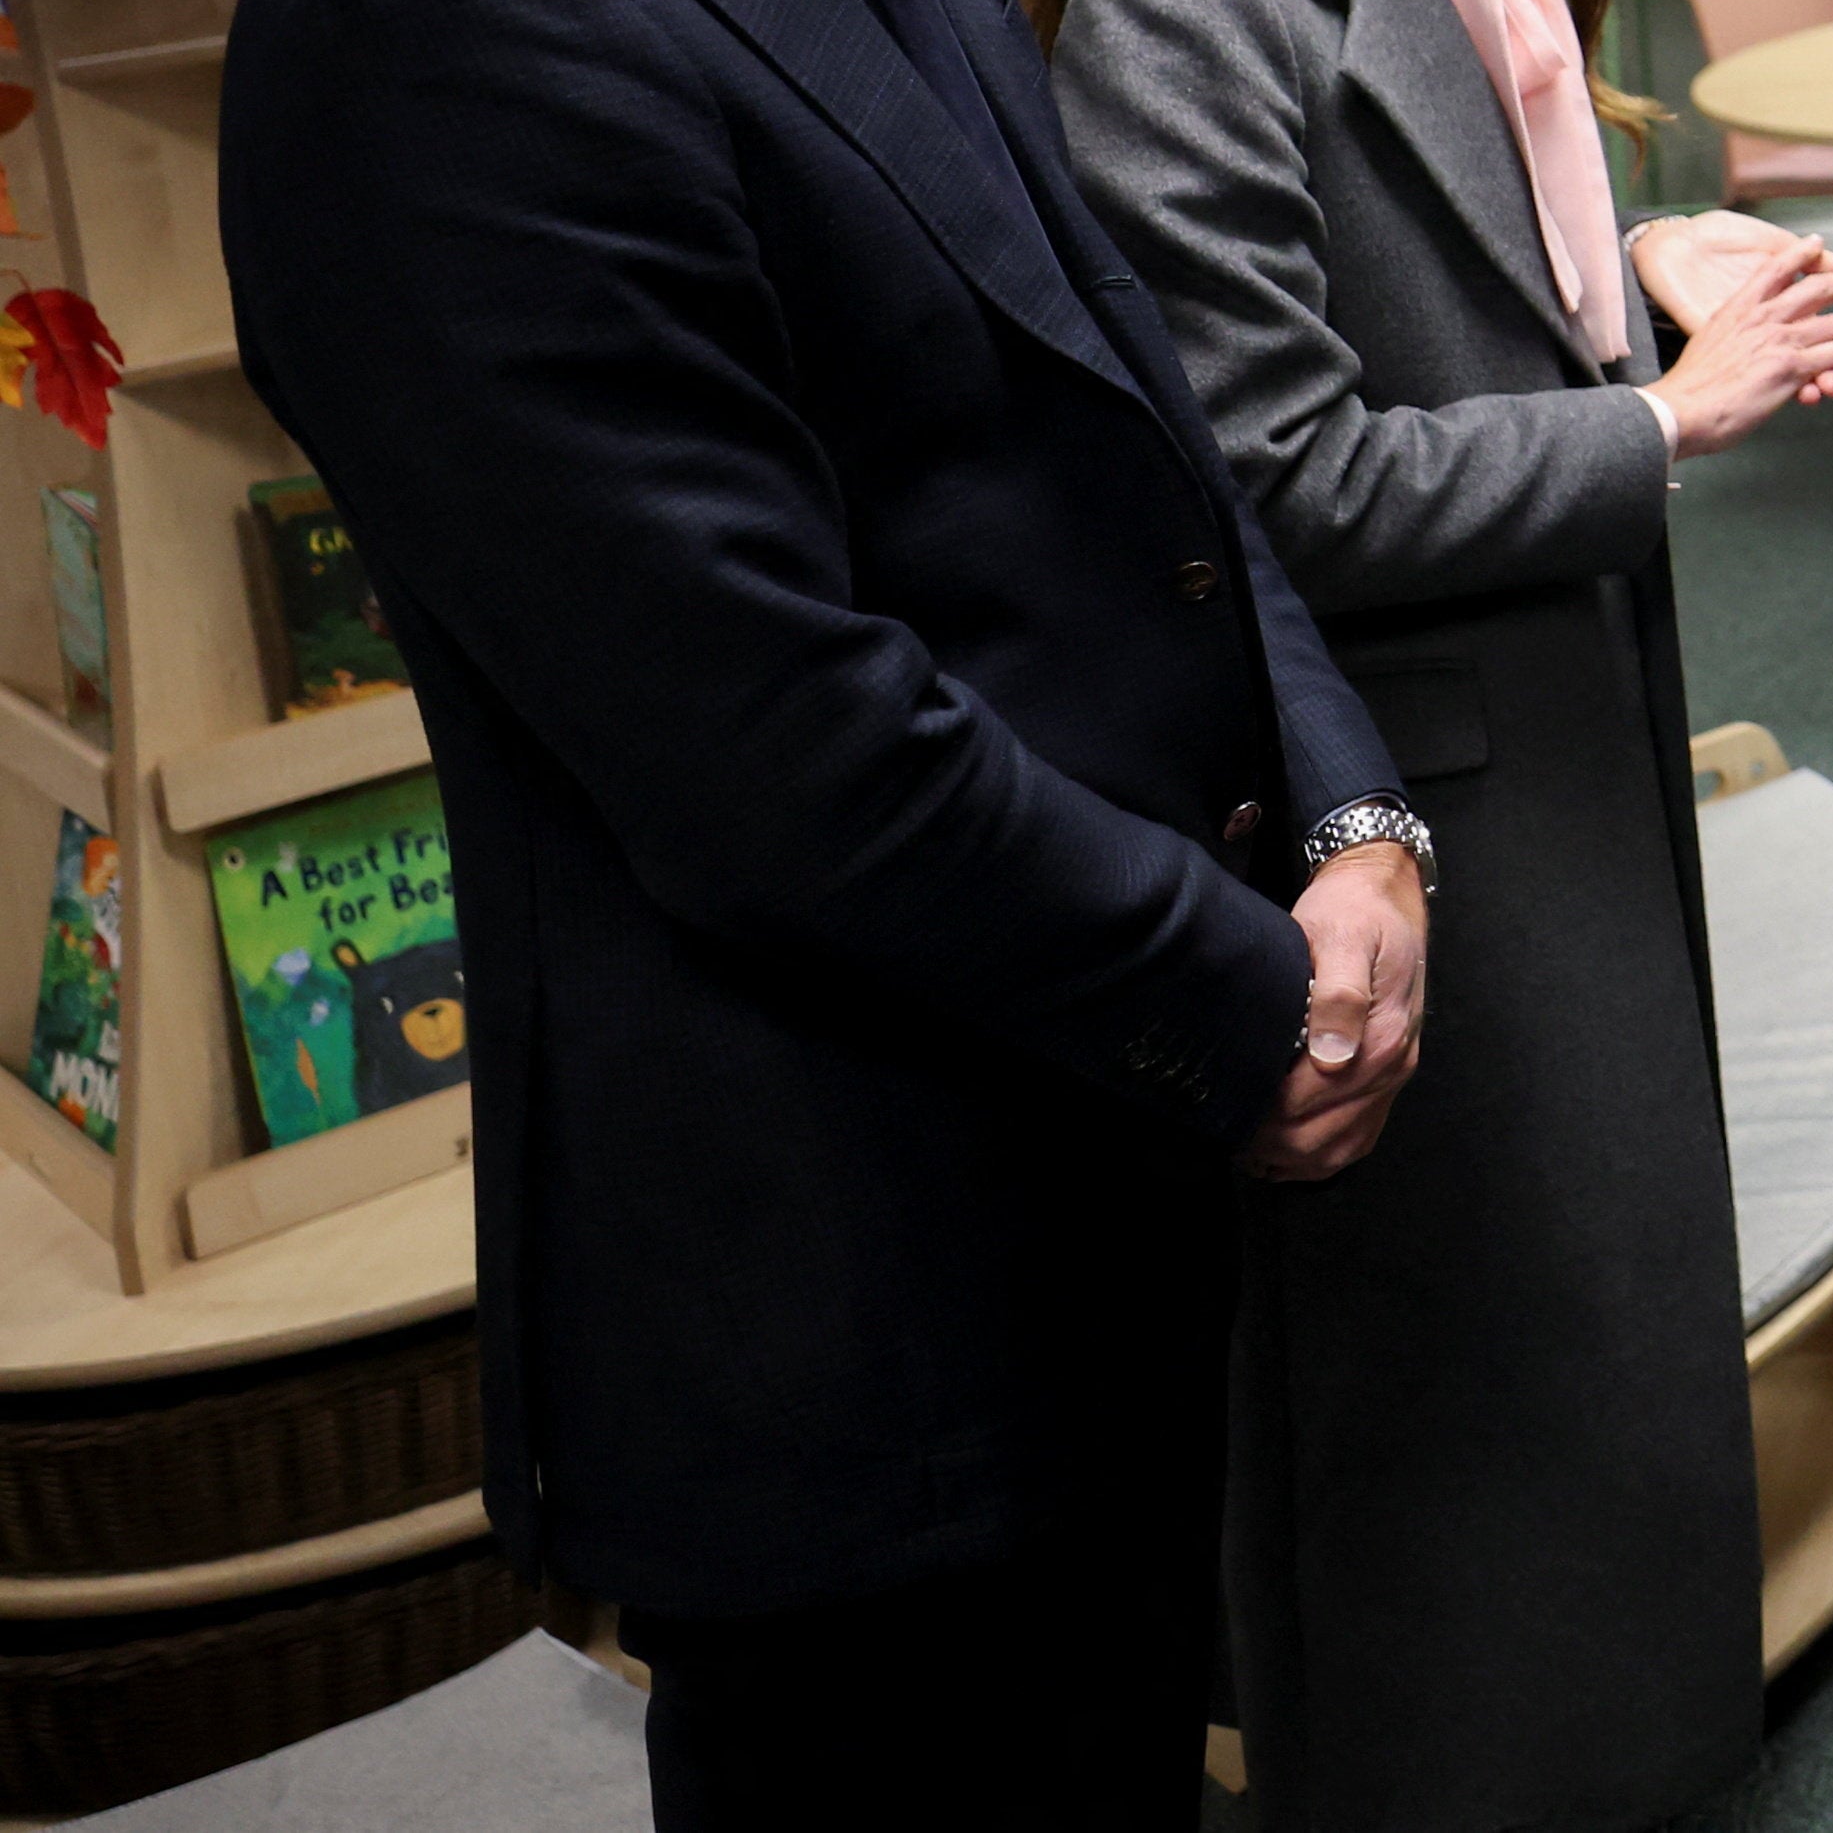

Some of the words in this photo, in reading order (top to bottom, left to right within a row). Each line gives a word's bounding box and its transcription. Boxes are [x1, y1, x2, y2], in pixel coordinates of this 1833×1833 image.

[261, 870, 289, 908] A
[301, 844, 382, 894] Best
[320, 894, 376, 933] for
